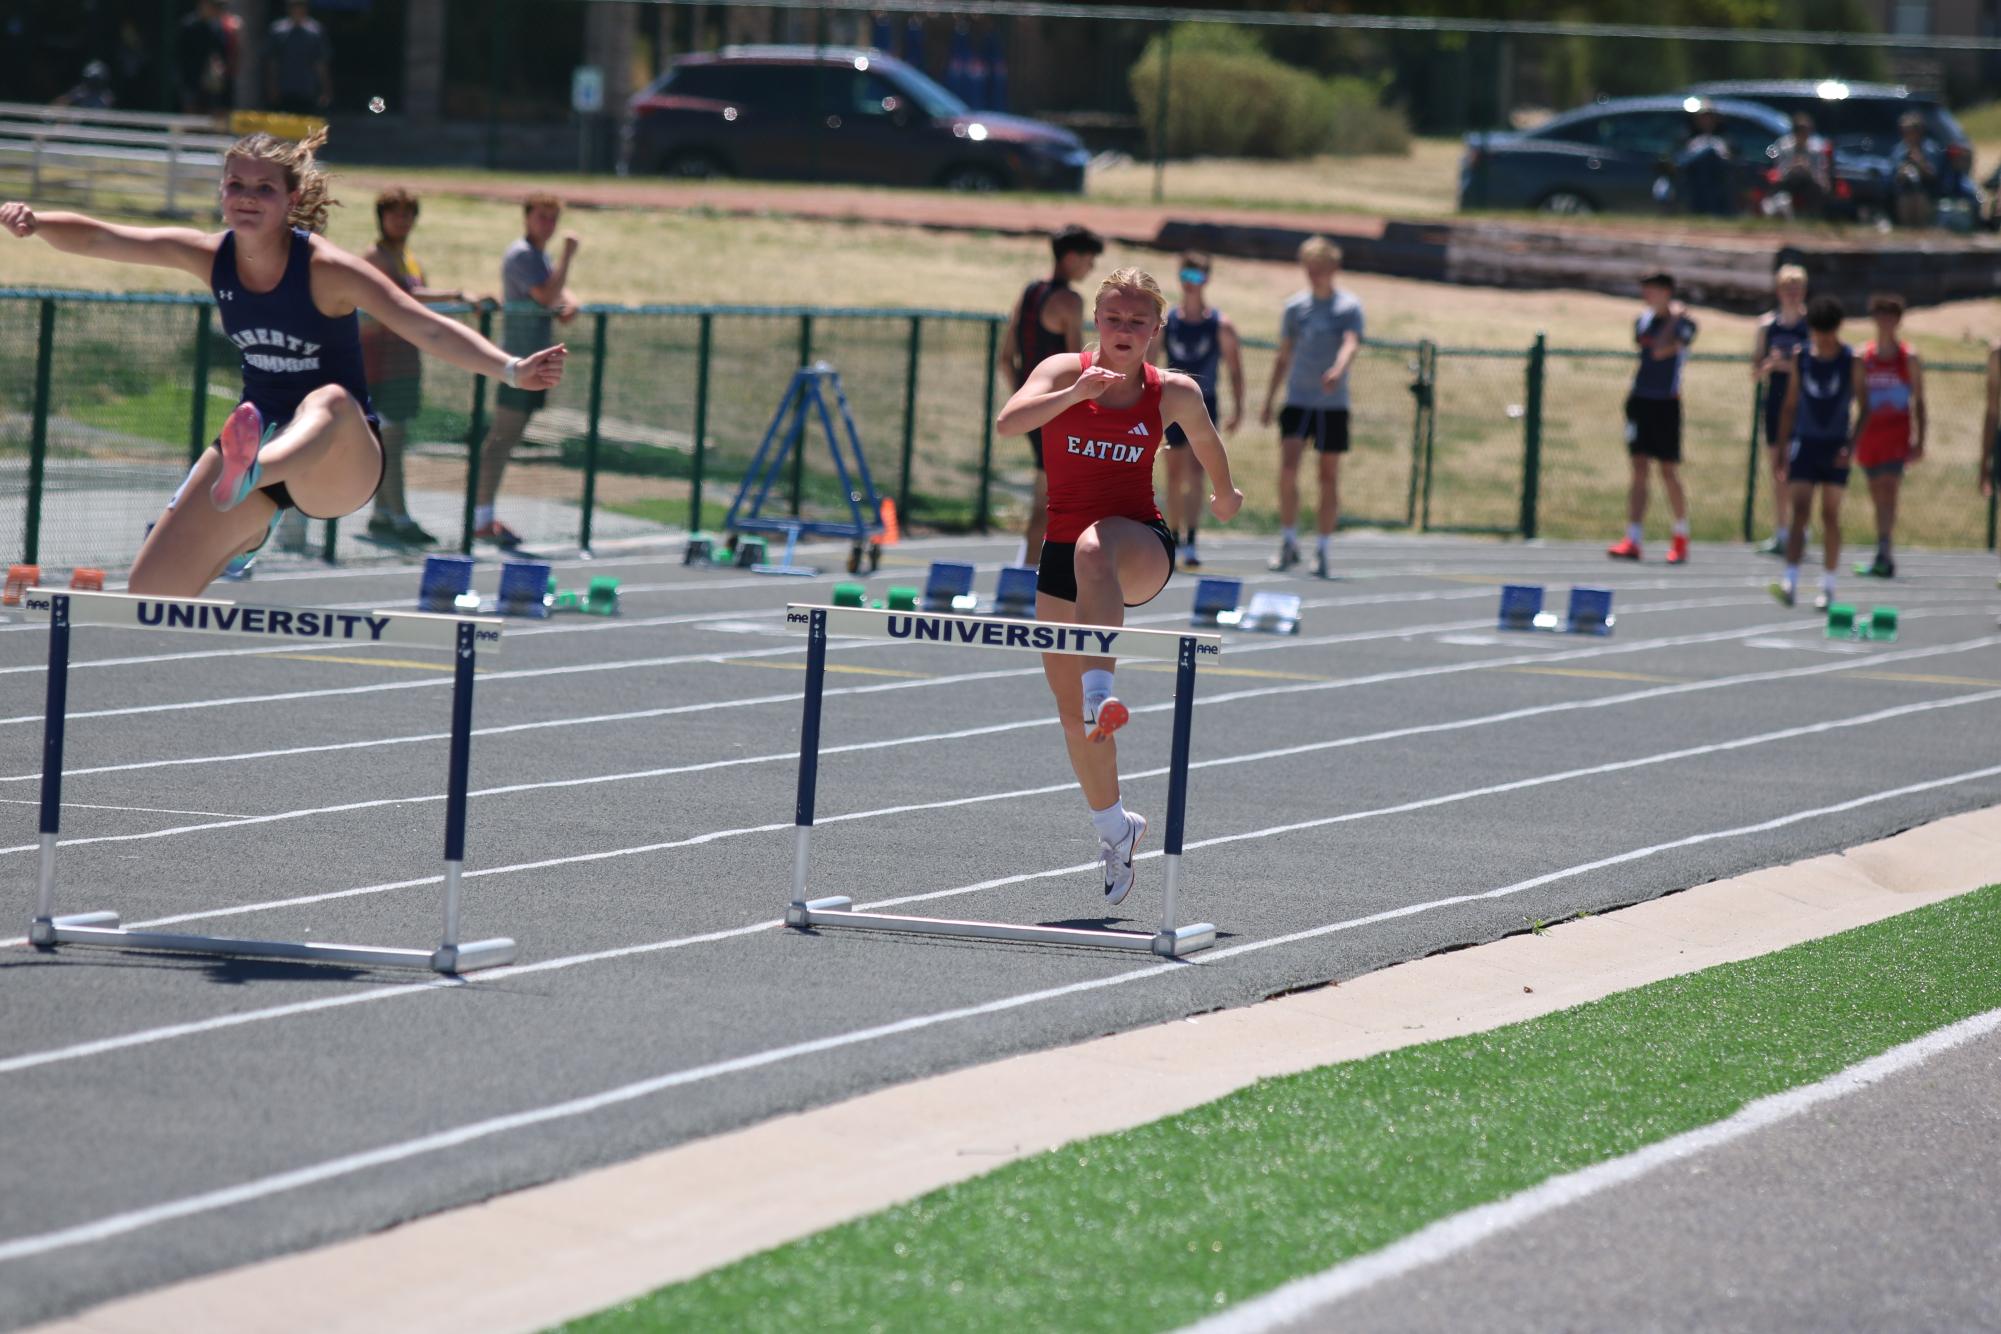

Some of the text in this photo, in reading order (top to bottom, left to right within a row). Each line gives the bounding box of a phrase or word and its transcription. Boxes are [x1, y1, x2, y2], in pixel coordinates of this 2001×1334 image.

[1067, 435, 1145, 463] EATON
[137, 601, 391, 641] UNIVERSITY
[887, 615, 1119, 654] UNIVERSITY
